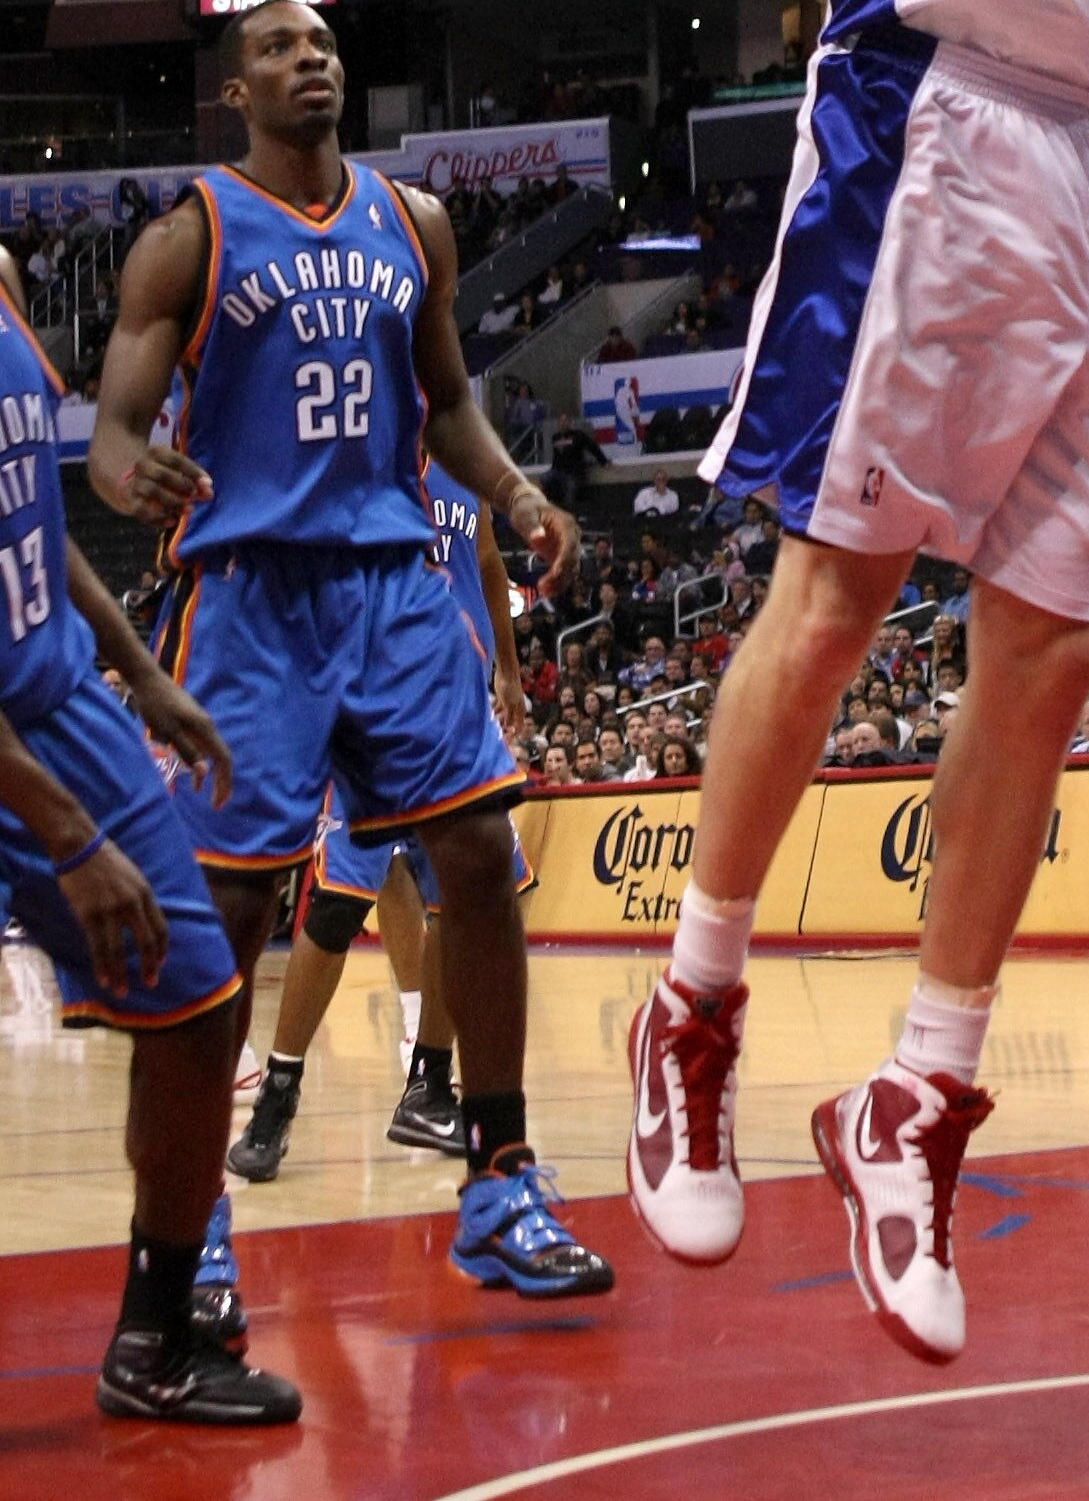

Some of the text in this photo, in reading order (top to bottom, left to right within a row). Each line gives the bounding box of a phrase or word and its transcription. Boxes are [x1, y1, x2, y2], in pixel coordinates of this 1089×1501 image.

[222, 249, 414, 328] OKLAHOMA
[291, 298, 371, 343] CITY
[295, 359, 373, 442] 22
[0, 526, 51, 642] 13
